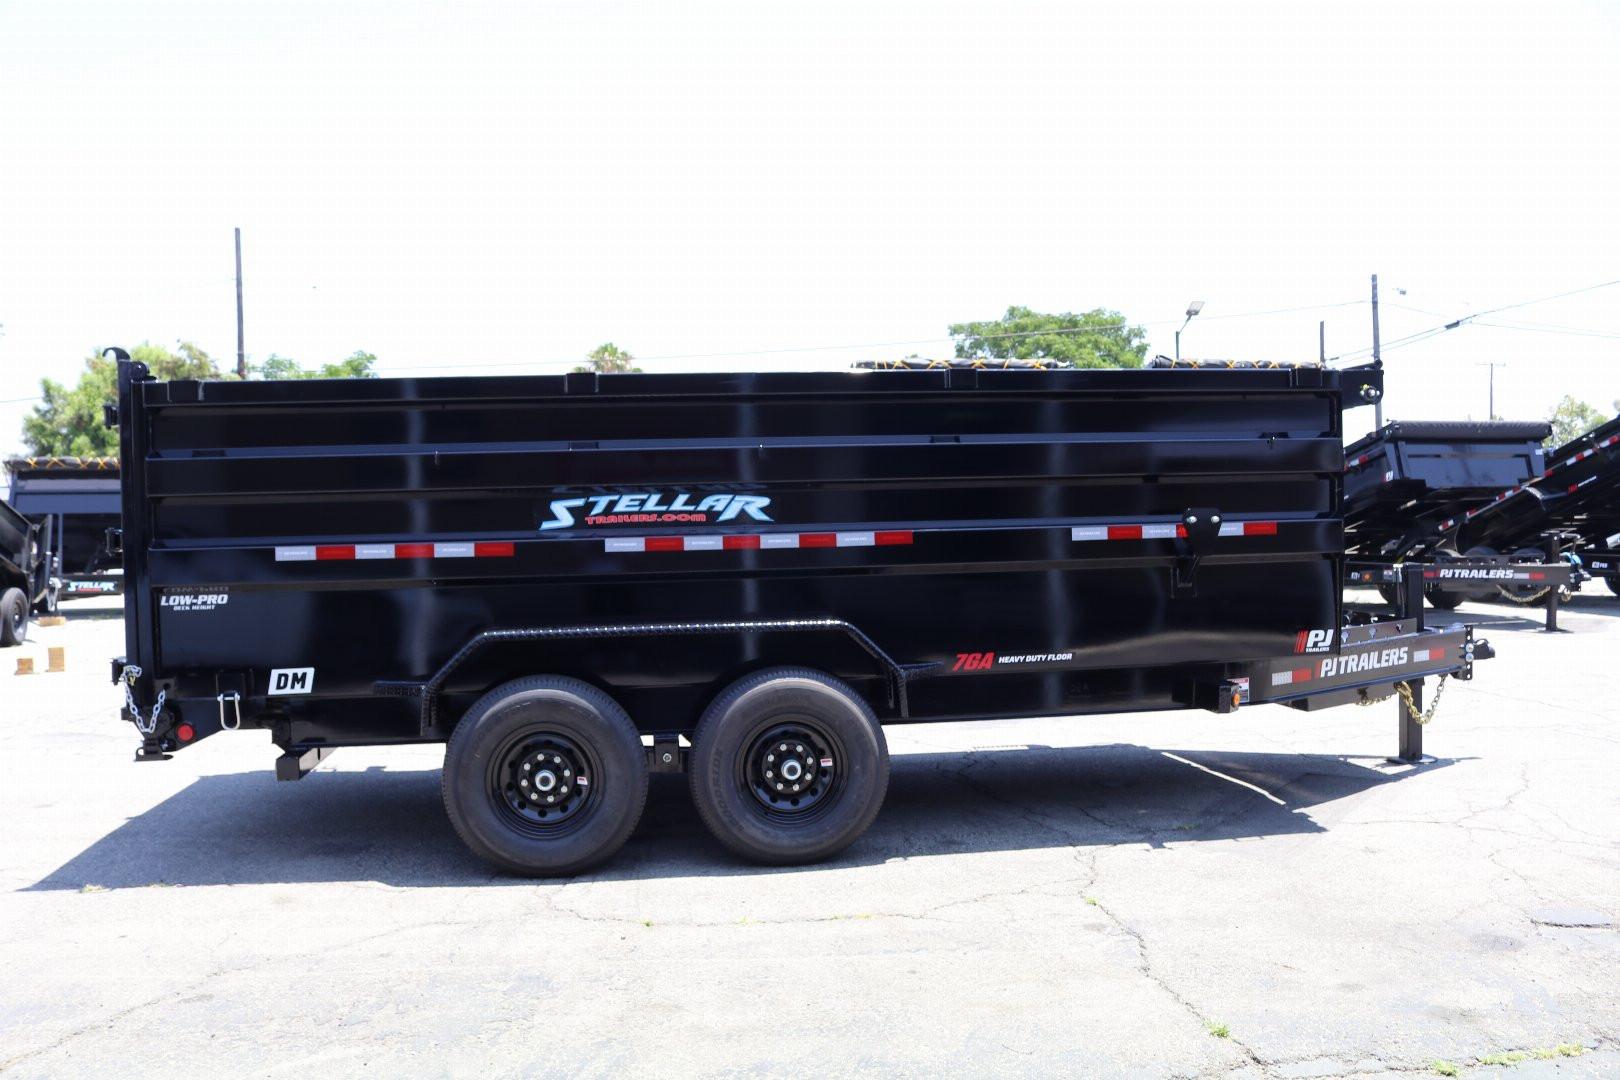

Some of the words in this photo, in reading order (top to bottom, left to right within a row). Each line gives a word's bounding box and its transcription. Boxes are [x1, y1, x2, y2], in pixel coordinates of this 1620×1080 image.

[538, 493, 774, 531] STELLAR
[585, 513, 706, 525] TRAILERS.COM
[160, 594, 228, 606] LOW-PRO
[1306, 629, 1334, 648] PJ
[951, 652, 995, 672] 7GA
[998, 655, 1025, 664] HEAVY
[1025, 653, 1047, 662] DUTY
[1047, 652, 1073, 661] FLOOR
[276, 672, 307, 690] DM
